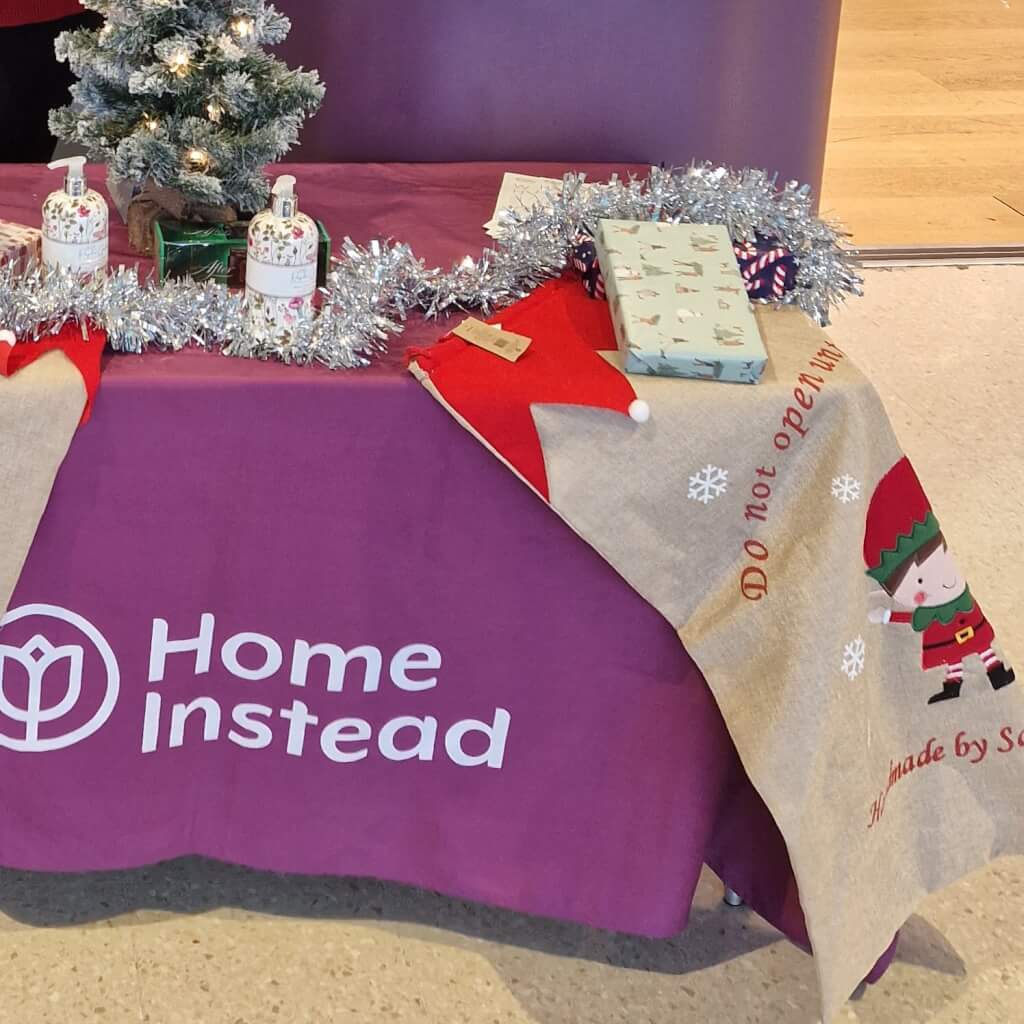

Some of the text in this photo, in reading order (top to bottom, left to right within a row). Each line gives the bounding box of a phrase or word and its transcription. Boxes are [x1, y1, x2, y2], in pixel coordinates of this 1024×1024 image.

[773, 372, 825, 451] open
[744, 465, 776, 522] not
[740, 539, 769, 602] Do
[148, 612, 442, 693] Home
[141, 690, 511, 769] Instead
[954, 730, 988, 764] by
